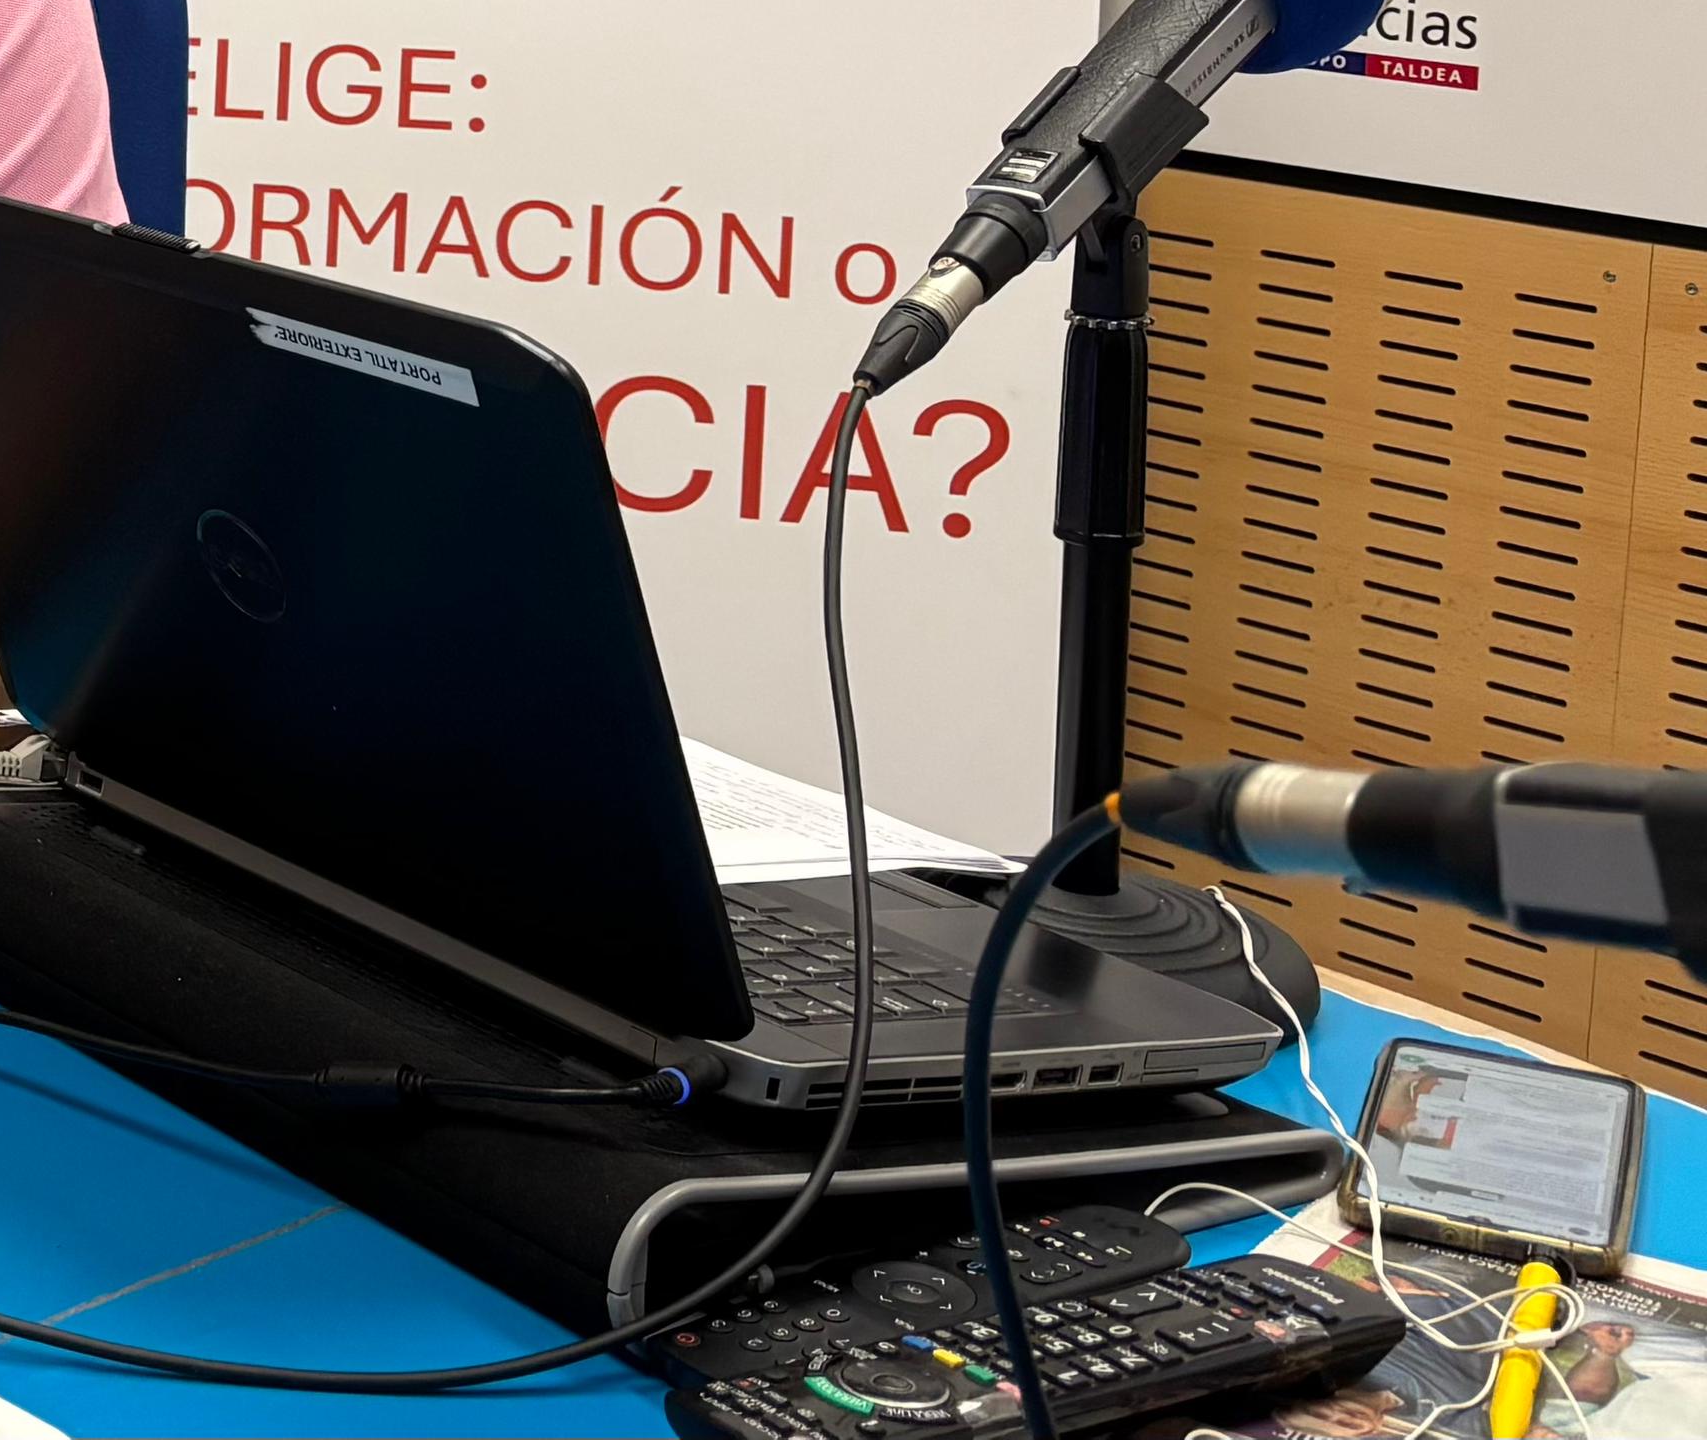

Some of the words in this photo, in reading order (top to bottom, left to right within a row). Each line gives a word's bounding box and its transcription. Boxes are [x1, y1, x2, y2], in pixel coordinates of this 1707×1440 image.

[1380, 60, 1464, 84] TALDEA
[185, 178, 795, 300] ORMACIÓN
[835, 241, 897, 306] o
[274, 325, 363, 362] EXTERIORE
[365, 349, 442, 386] PORTATIL
[597, 374, 1011, 539] CIA?
